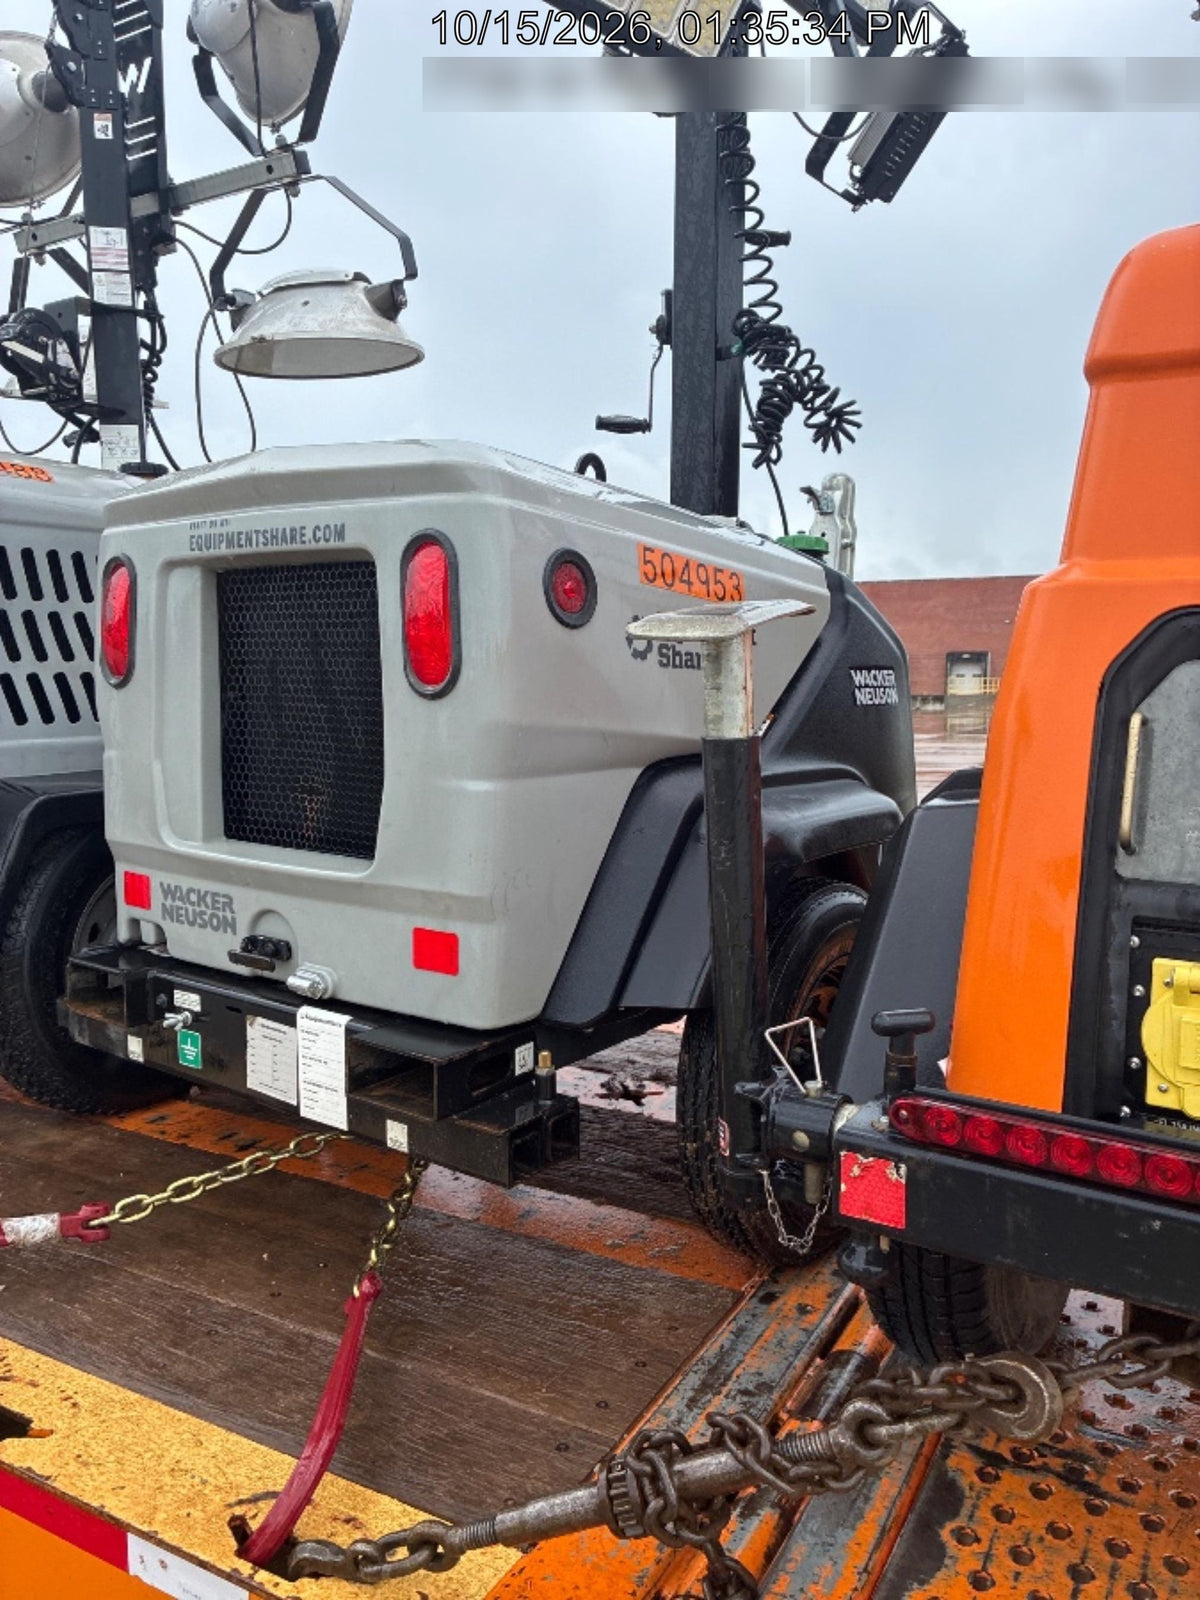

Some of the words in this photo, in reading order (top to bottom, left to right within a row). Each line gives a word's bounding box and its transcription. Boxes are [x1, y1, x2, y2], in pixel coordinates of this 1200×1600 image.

[189, 523, 346, 552] EQUIPMENTSHARE.COM
[642, 546, 743, 602] 504953
[849, 669, 897, 687] WACKER
[854, 687, 899, 705] NEUSON
[160, 882, 236, 914] WACKER
[161, 903, 237, 936] NEUSON
